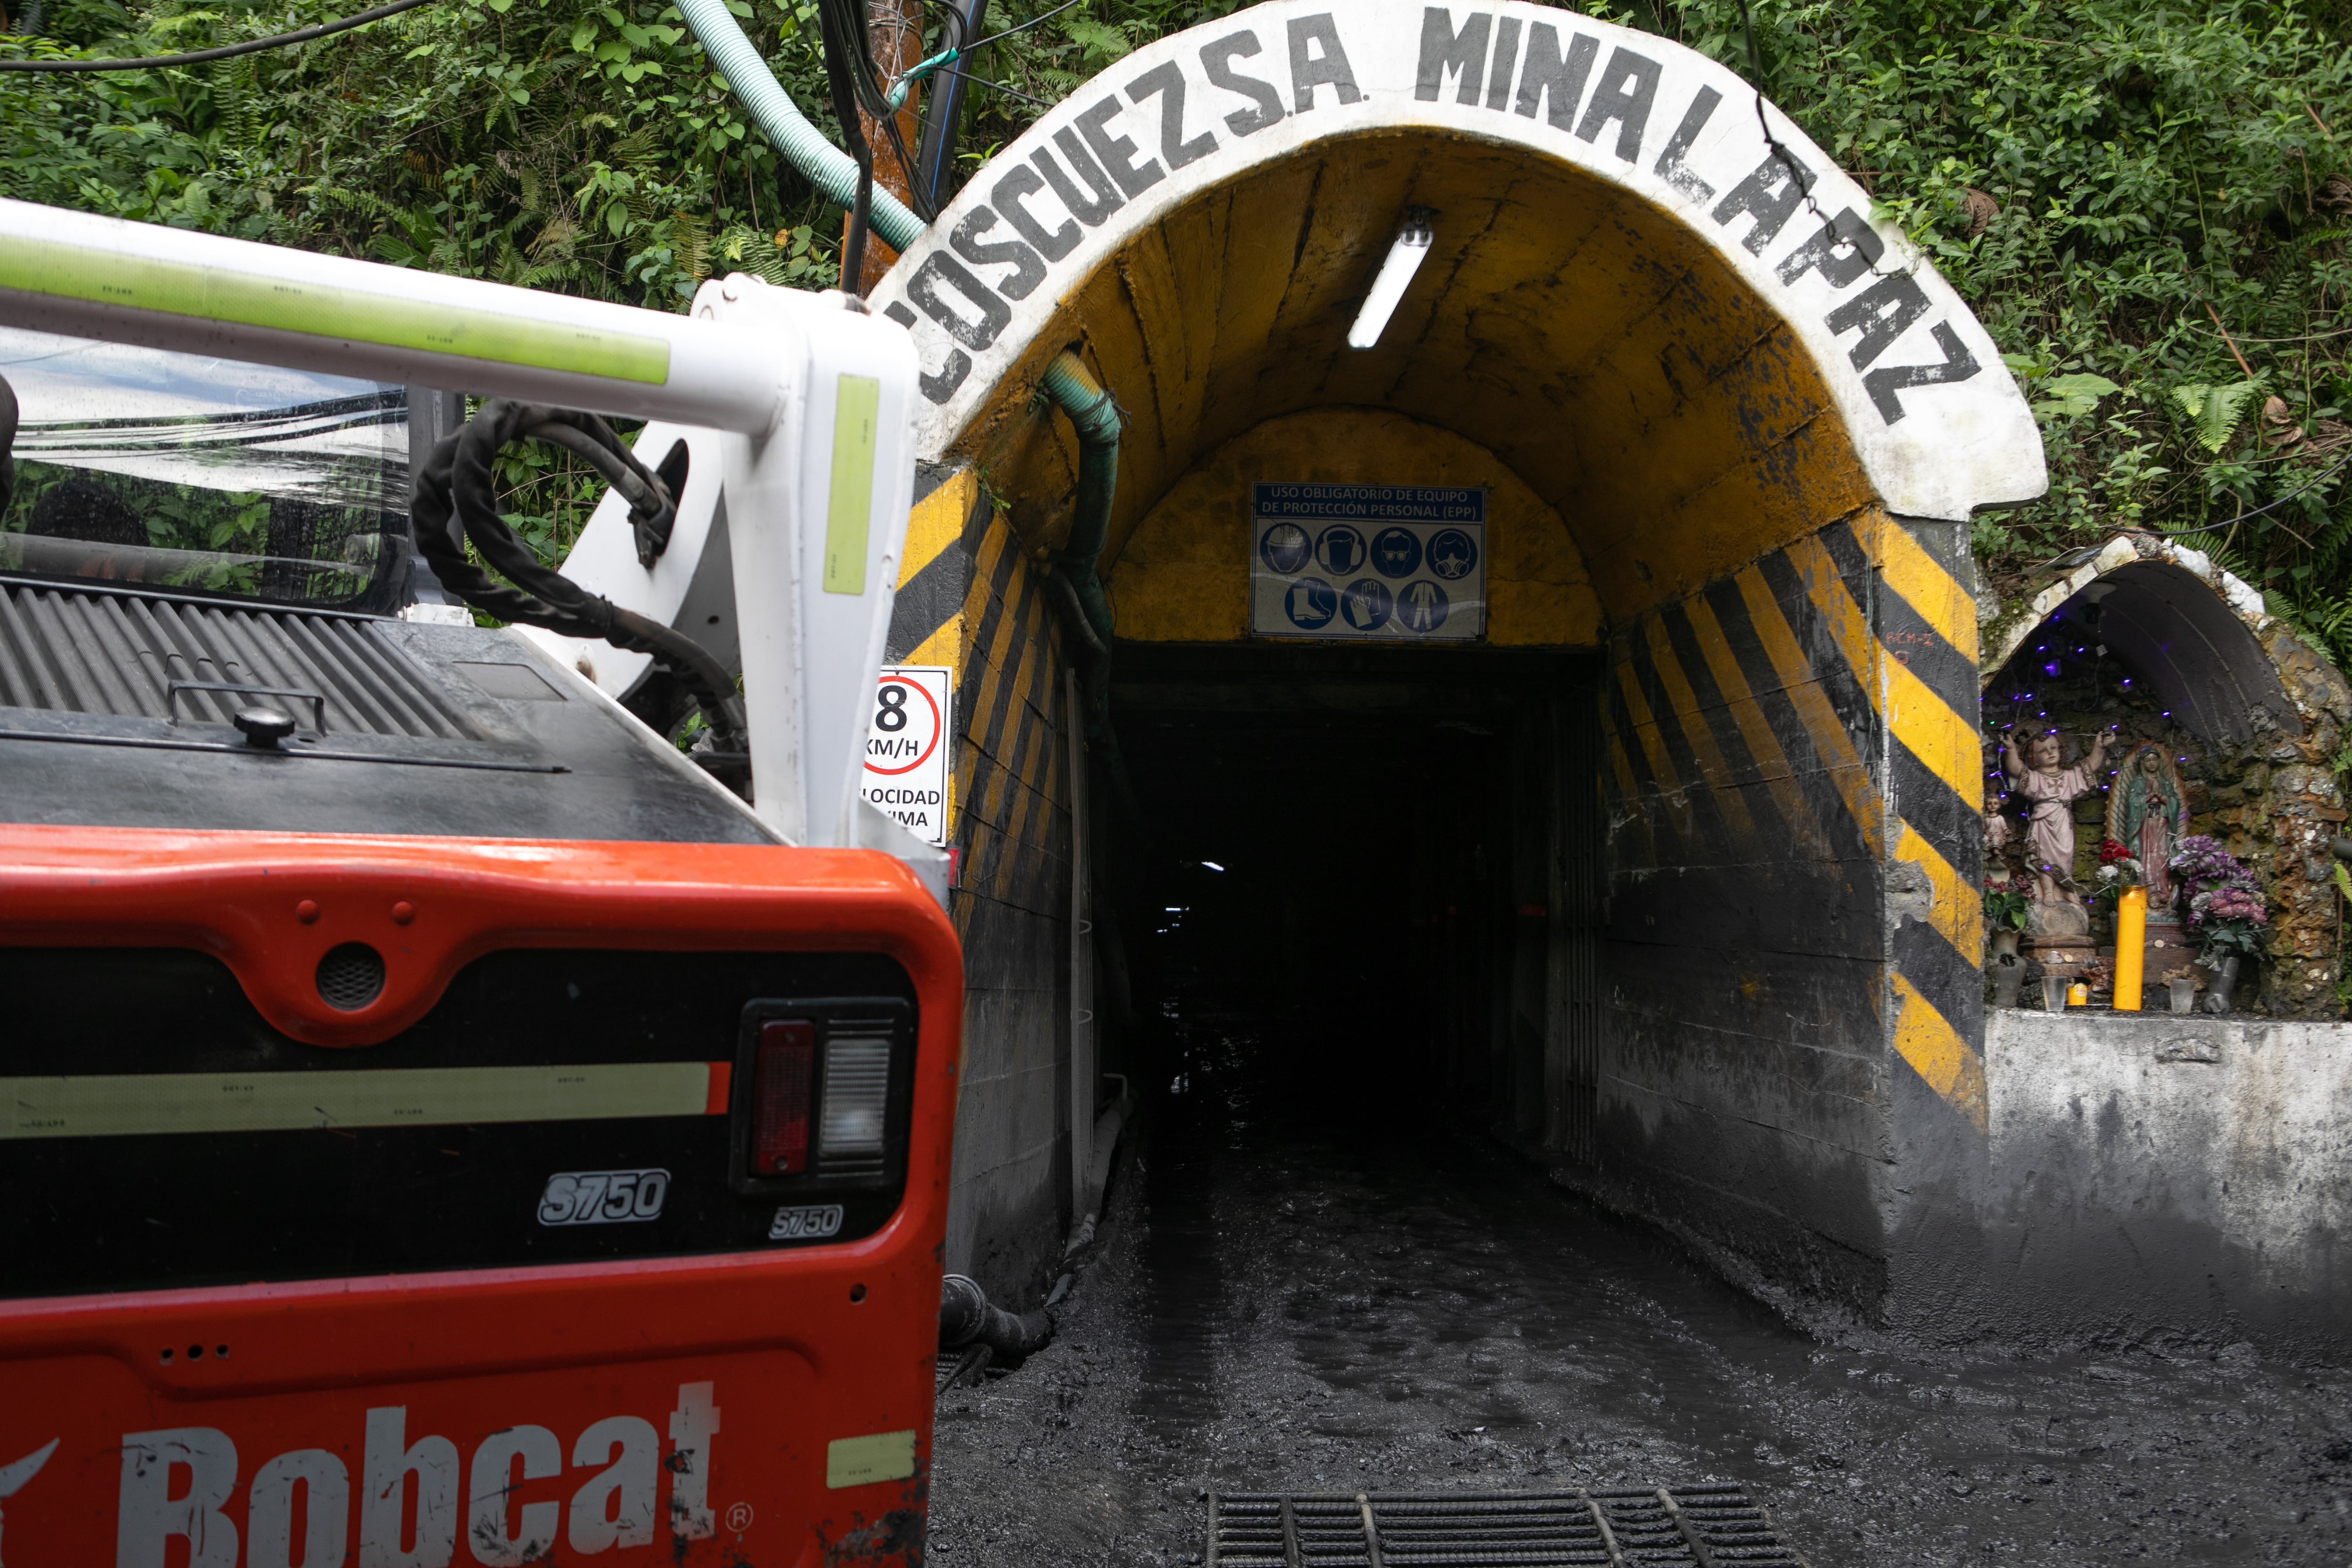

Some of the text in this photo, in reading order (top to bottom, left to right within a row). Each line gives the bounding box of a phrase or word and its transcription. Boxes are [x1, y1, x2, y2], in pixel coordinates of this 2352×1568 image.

[1414, 7, 1663, 164] MINA
[1653, 84, 1818, 258] LA
[1774, 206, 1981, 426] PAZ
[1262, 501, 1476, 520] DE PROTECCIÓN PERSONAL (EPP)
[1271, 486, 1467, 502] USO OBLIGATORIO DE EQUIPO
[875, 685, 907, 732] 8
[540, 1171, 668, 1223] S750
[771, 1208, 840, 1236] S750
[115, 1381, 721, 1568] Bobcat
